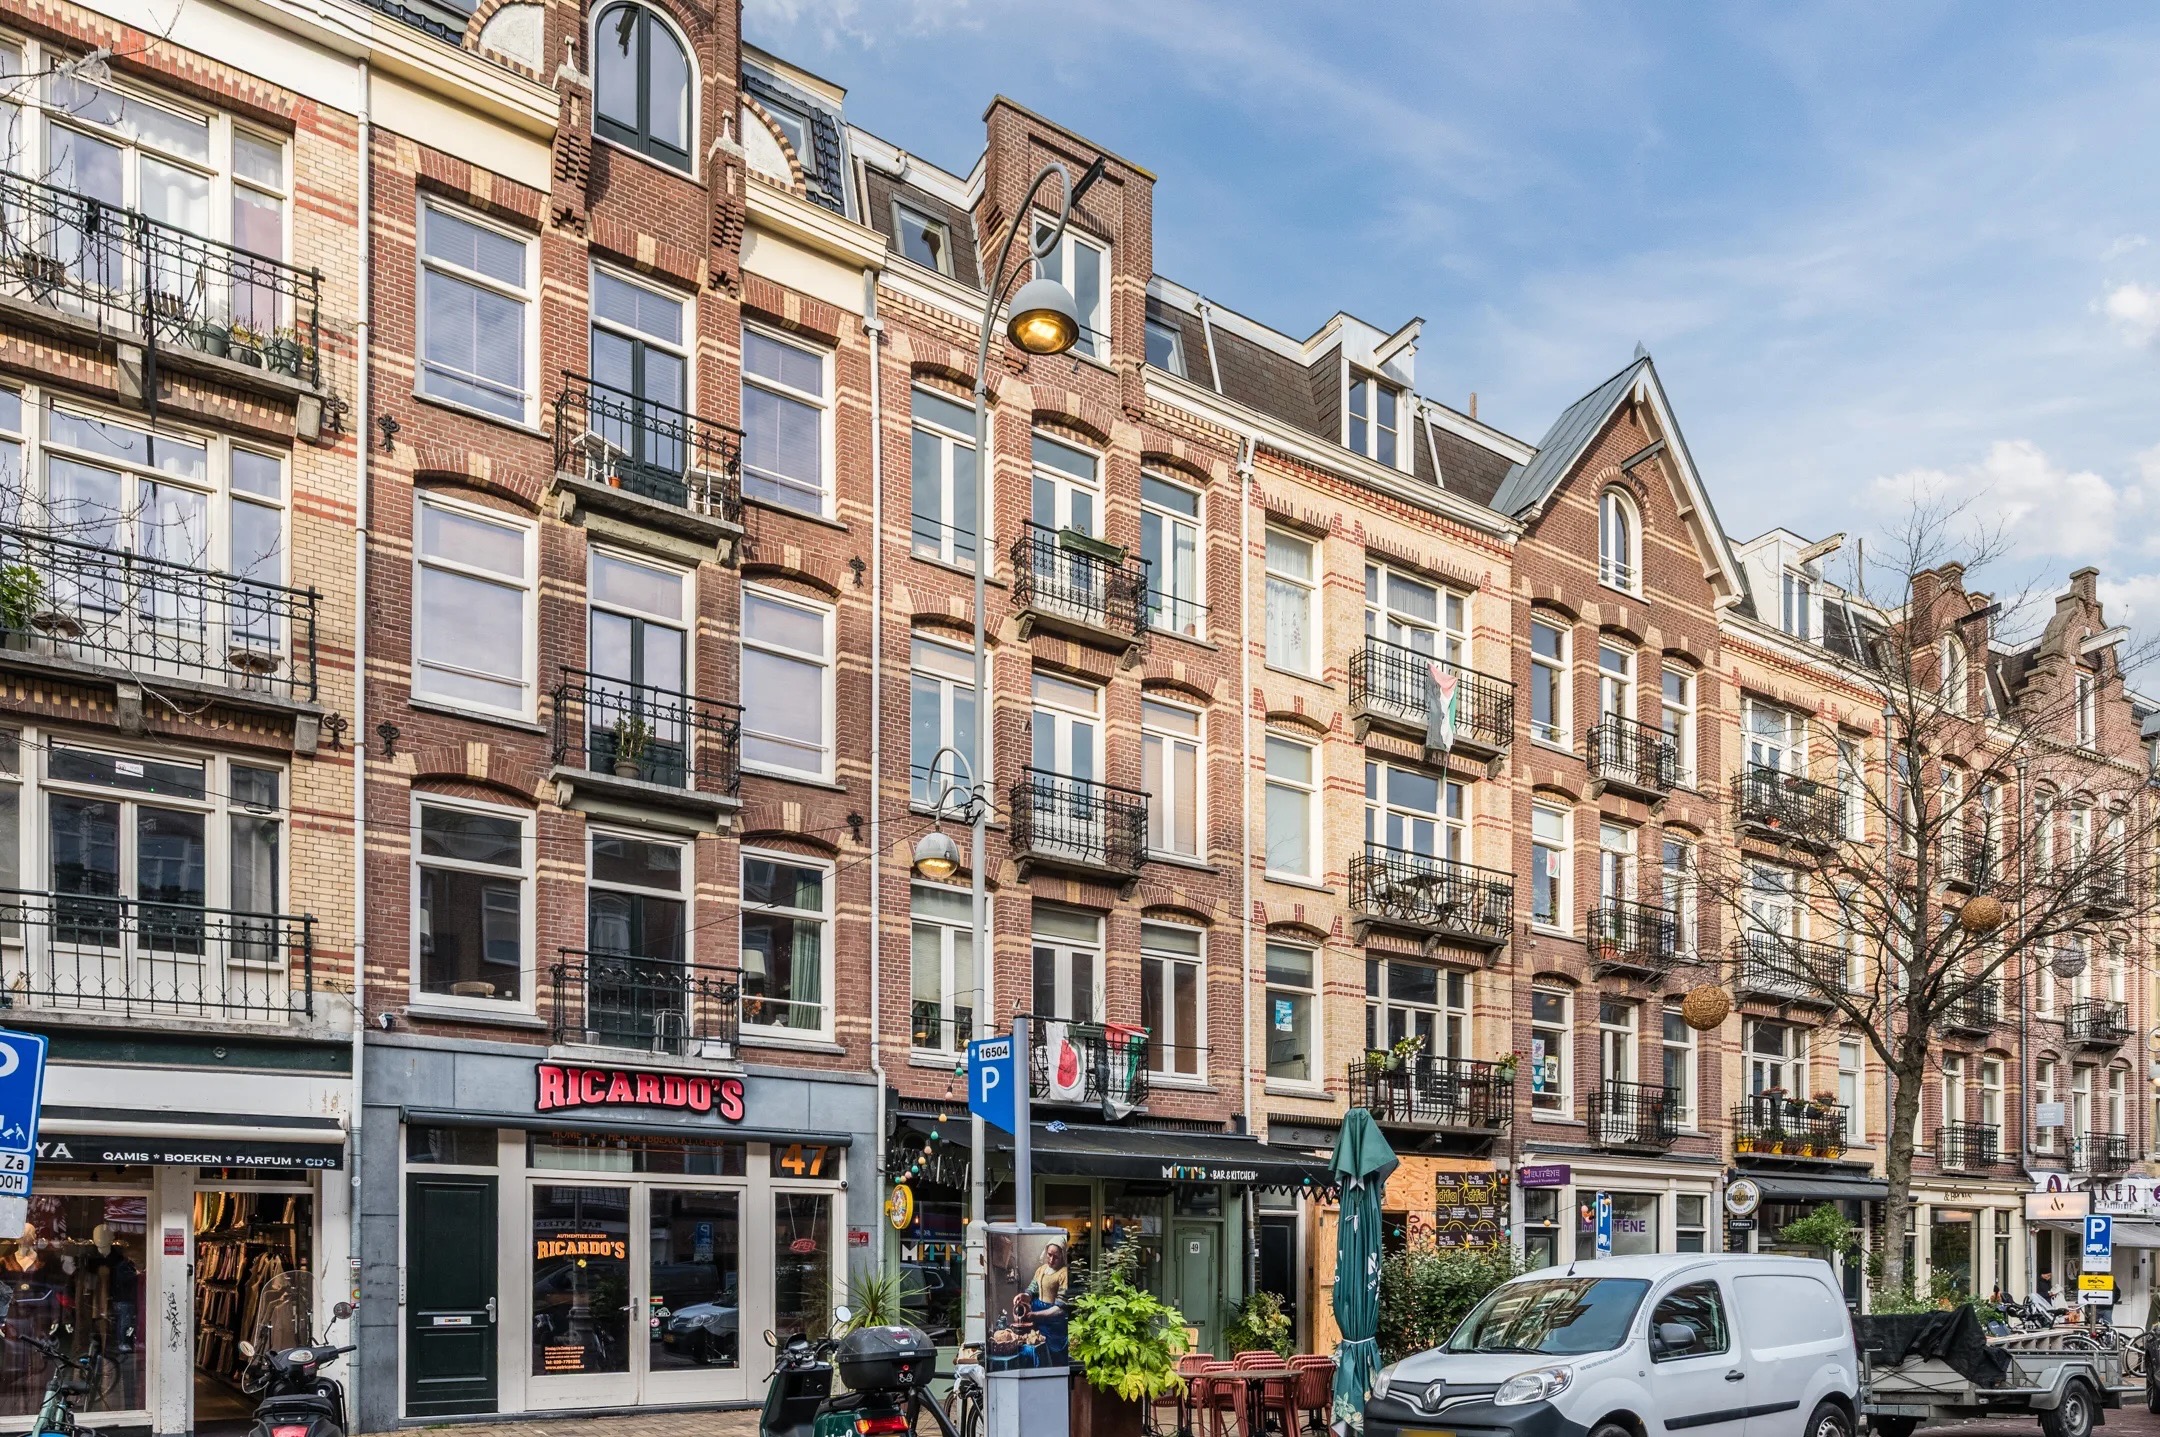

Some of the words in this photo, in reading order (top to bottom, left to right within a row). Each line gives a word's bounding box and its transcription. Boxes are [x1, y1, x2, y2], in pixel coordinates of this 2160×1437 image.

[980, 1046, 1008, 1059] 16504
[982, 1066, 1000, 1103] P
[538, 1065, 744, 1121] RICARDO'S
[5, 1155, 24, 1170] Za
[103, 1152, 149, 1161] QAMIS
[164, 1154, 221, 1163] BOEKEN
[236, 1156, 292, 1165] PARFUM
[305, 1158, 335, 1167] CD'S
[781, 1144, 828, 1175] 47
[2050, 1196, 2064, 1211] &
[1600, 1199, 1609, 1227] P
[2091, 1219, 2106, 1239] P
[537, 1241, 625, 1259] RICARDO'S
[793, 1241, 812, 1251] OPEN
[1191, 1244, 1198, 1252] 49
